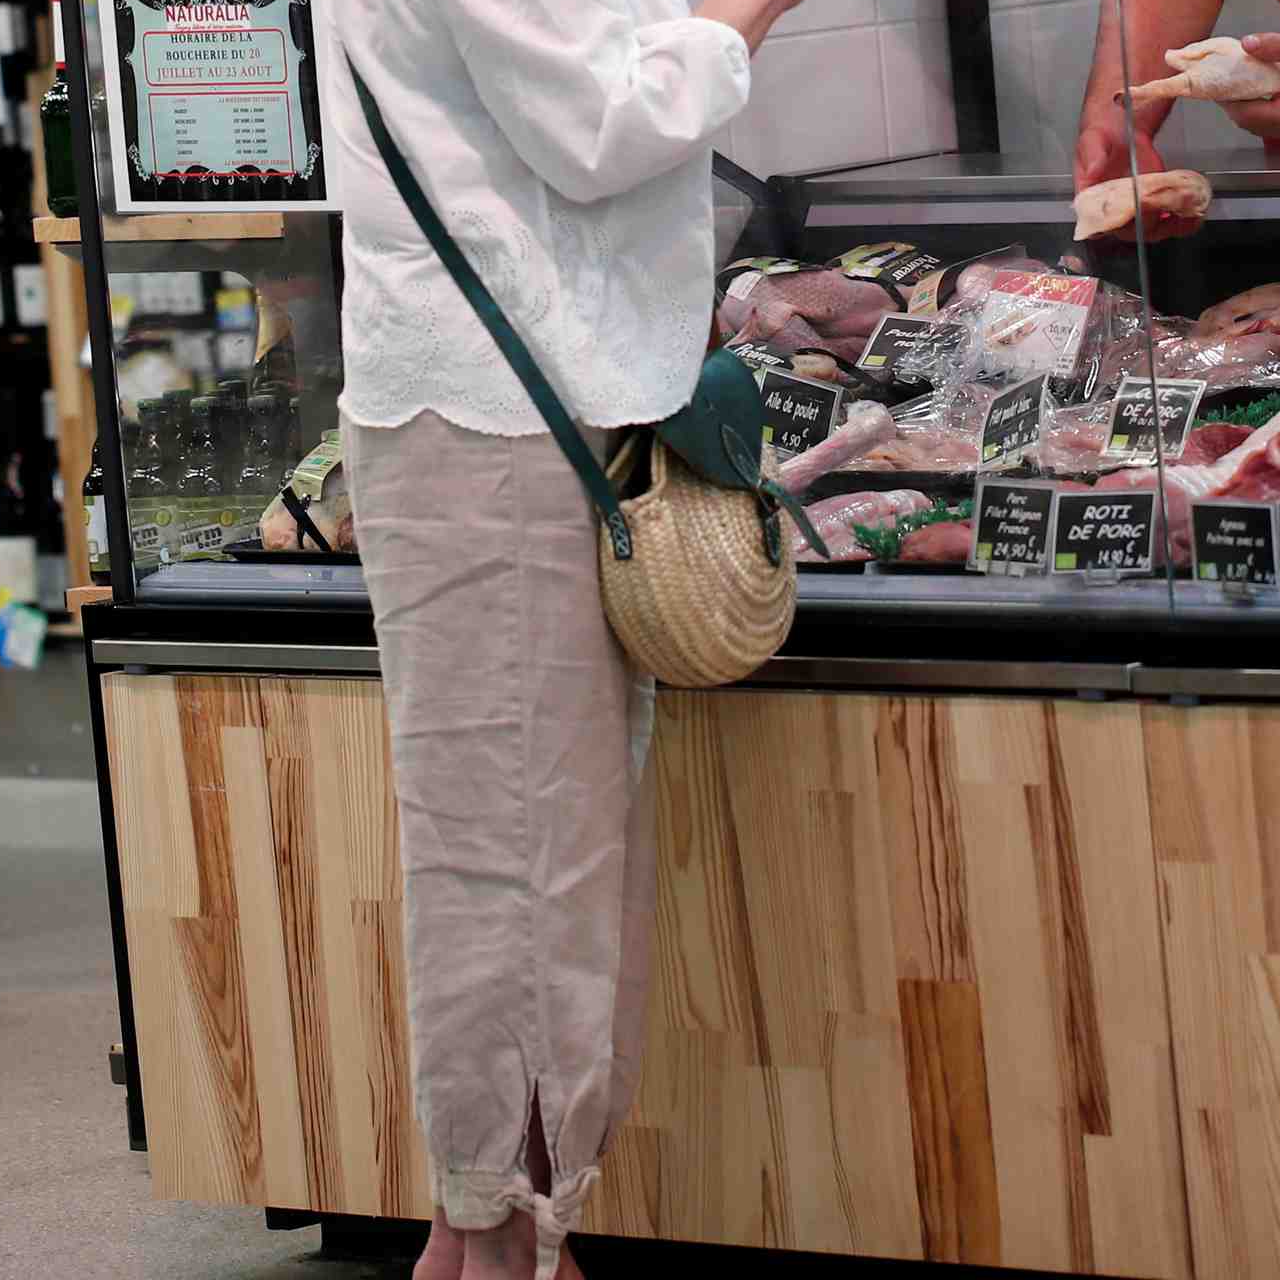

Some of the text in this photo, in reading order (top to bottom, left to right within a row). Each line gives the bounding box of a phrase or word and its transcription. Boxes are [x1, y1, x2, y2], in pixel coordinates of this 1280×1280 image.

[165, 5, 249, 22] NATURALIA
[170, 32, 253, 44] HORAIRE DE LA
[166, 49, 229, 61] BOUCHERIE
[232, 49, 245, 61] DU
[158, 67, 205, 82] JUILLET
[207, 68, 221, 78] AU
[782, 395, 793, 413] de
[792, 402, 819, 421] poulet
[1122, 404, 1145, 418] DE
[1006, 492, 1028, 505] Porc
[985, 506, 1042, 523] Filet Mignon
[1083, 504, 1132, 520] ROTI
[997, 522, 1029, 535] France
[1068, 523, 1145, 540] DE PORC
